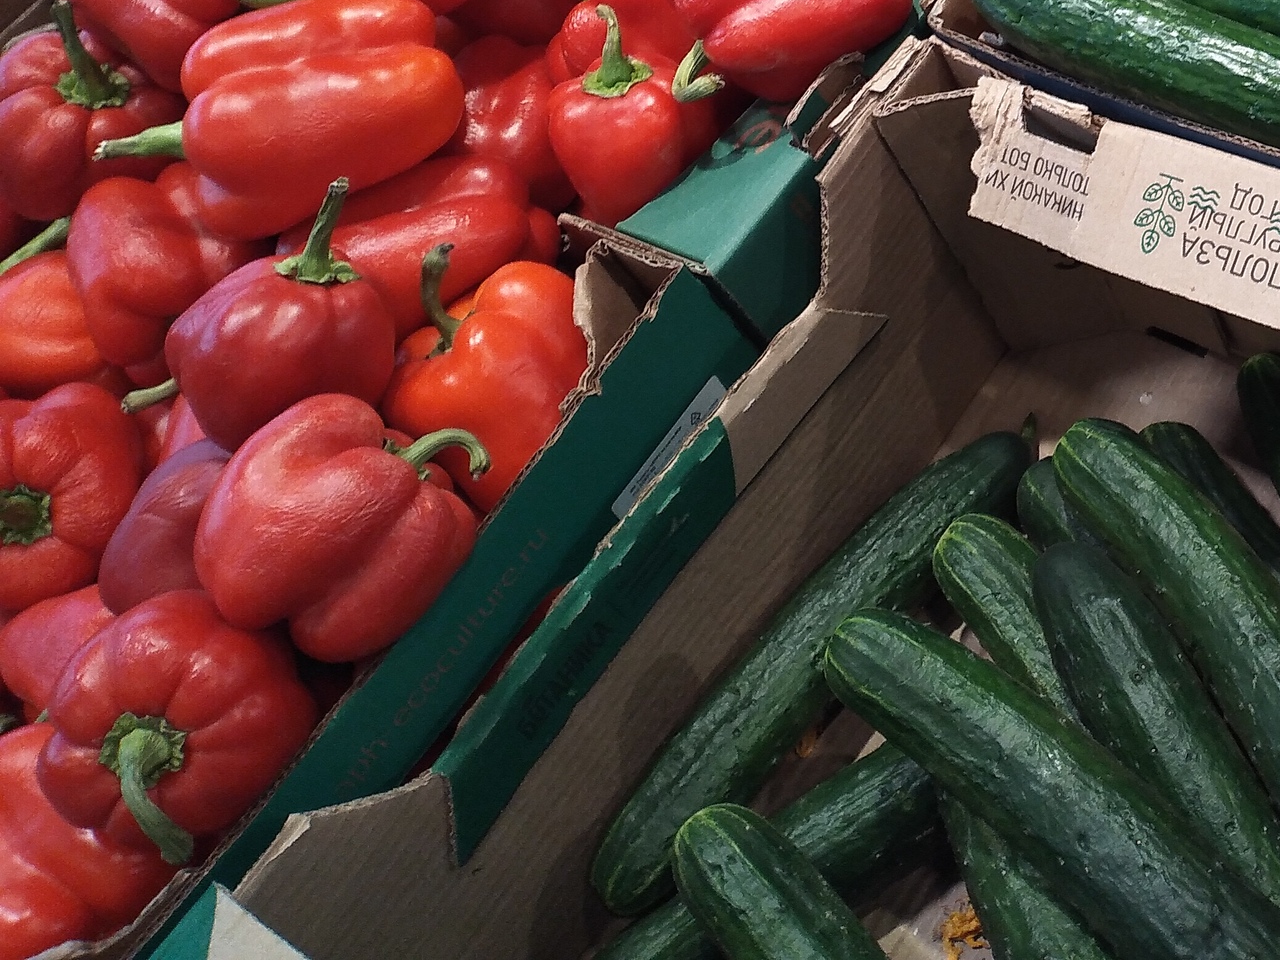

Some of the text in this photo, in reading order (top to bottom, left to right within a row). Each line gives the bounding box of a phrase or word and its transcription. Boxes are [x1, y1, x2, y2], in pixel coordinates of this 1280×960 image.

[1033, 157, 1091, 196] ТОЛЬКО
[1010, 176, 1084, 222] НИКАКОЙ
[1229, 182, 1279, 220] ГОД
